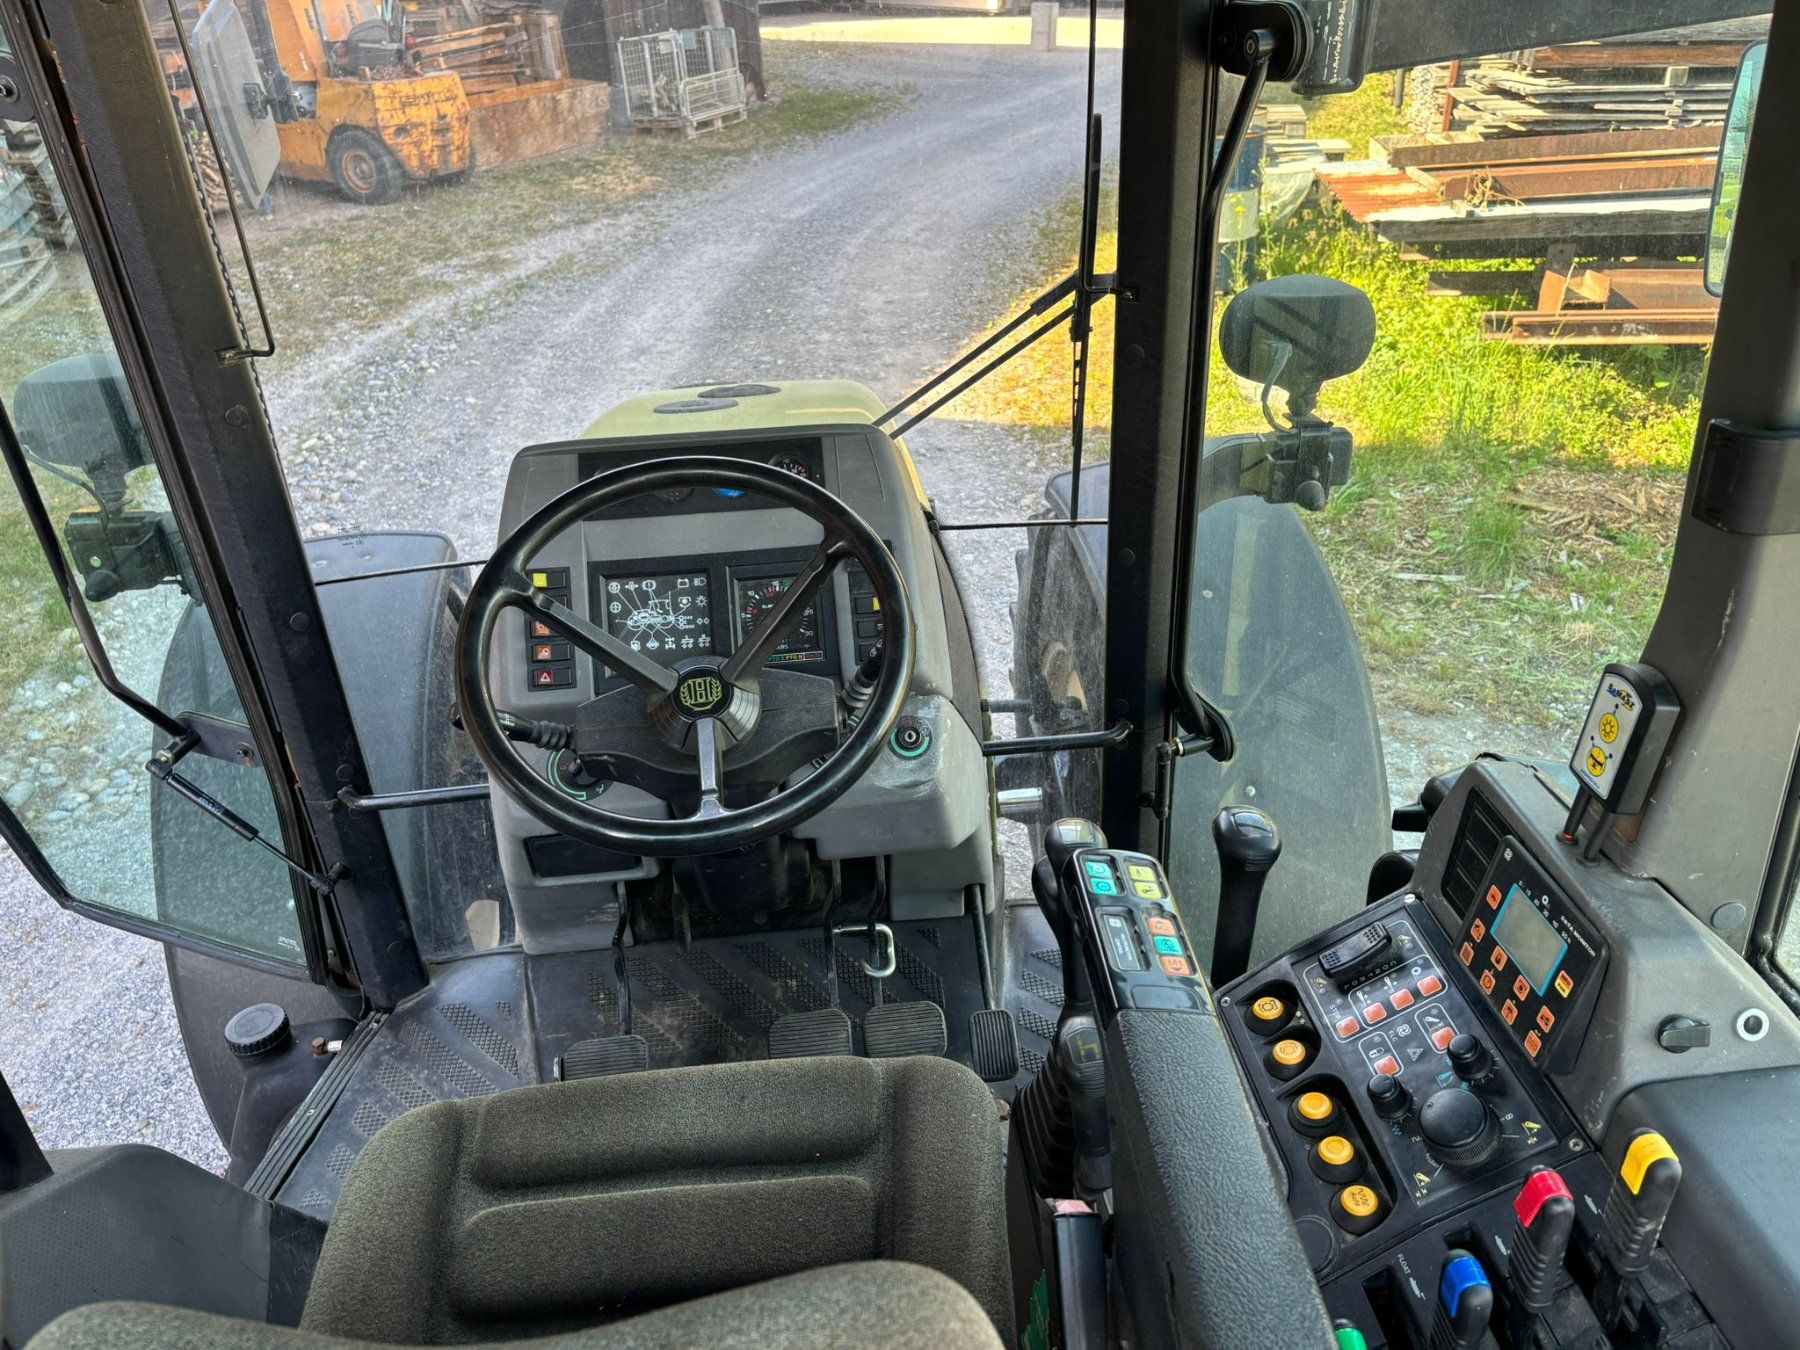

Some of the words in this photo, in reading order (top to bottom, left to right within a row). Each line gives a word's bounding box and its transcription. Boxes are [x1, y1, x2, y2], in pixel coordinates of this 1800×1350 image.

[1560, 915, 1574, 932] DATA
[1573, 930, 1596, 957] MONITOR
[1344, 960, 1397, 989] CONTROL
[1330, 1004, 1341, 1019] STOP
[1388, 1030, 1398, 1042] ELC
[1397, 1253, 1411, 1275] FLOAT
